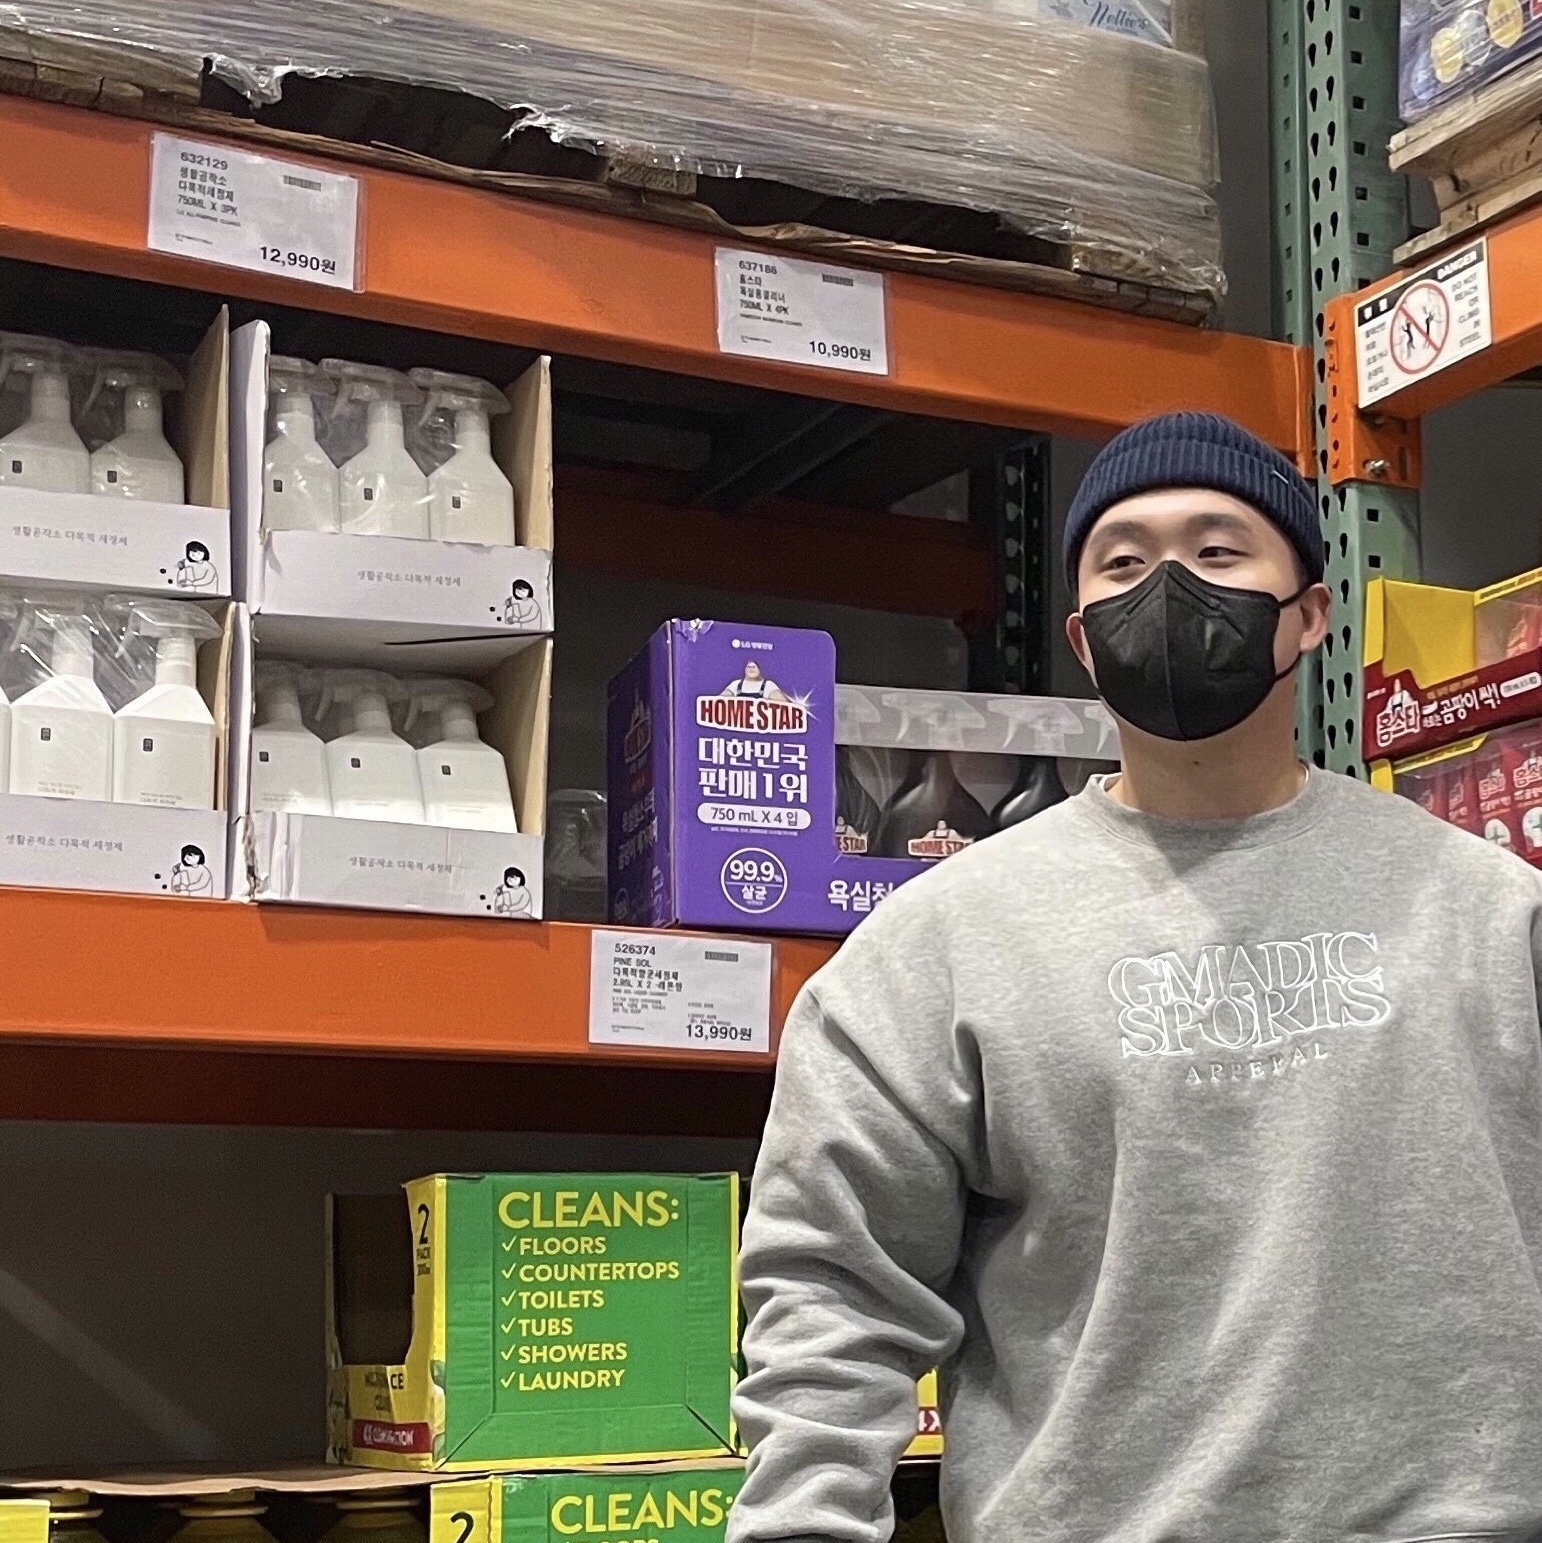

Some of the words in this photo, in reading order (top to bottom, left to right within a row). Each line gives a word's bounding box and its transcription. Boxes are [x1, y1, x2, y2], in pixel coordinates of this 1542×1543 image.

[180, 152, 228, 170] 632129
[260, 246, 336, 275] 12,990원
[809, 340, 871, 361] 10,990원
[698, 737, 808, 770] 대한민국
[711, 807, 735, 821] 750
[761, 811, 770, 823] X
[773, 811, 782, 823] 4
[742, 884, 767, 901] 살균
[614, 944, 656, 956] 526374
[1108, 932, 1384, 1009] GMADIC
[1118, 975, 1391, 1058] SPORTS
[686, 1024, 752, 1041] 13,990원
[498, 1190, 679, 1229] CLEANS:
[519, 1236, 607, 1255] FLOORS
[519, 1261, 680, 1282] COUNTERTOPS
[519, 1289, 605, 1309] TOILETS
[518, 1318, 573, 1337] TUBS
[518, 1342, 628, 1363] SHOWERS
[519, 1369, 625, 1391] LAUNDRY
[551, 1489, 734, 1534] CLEANS:
